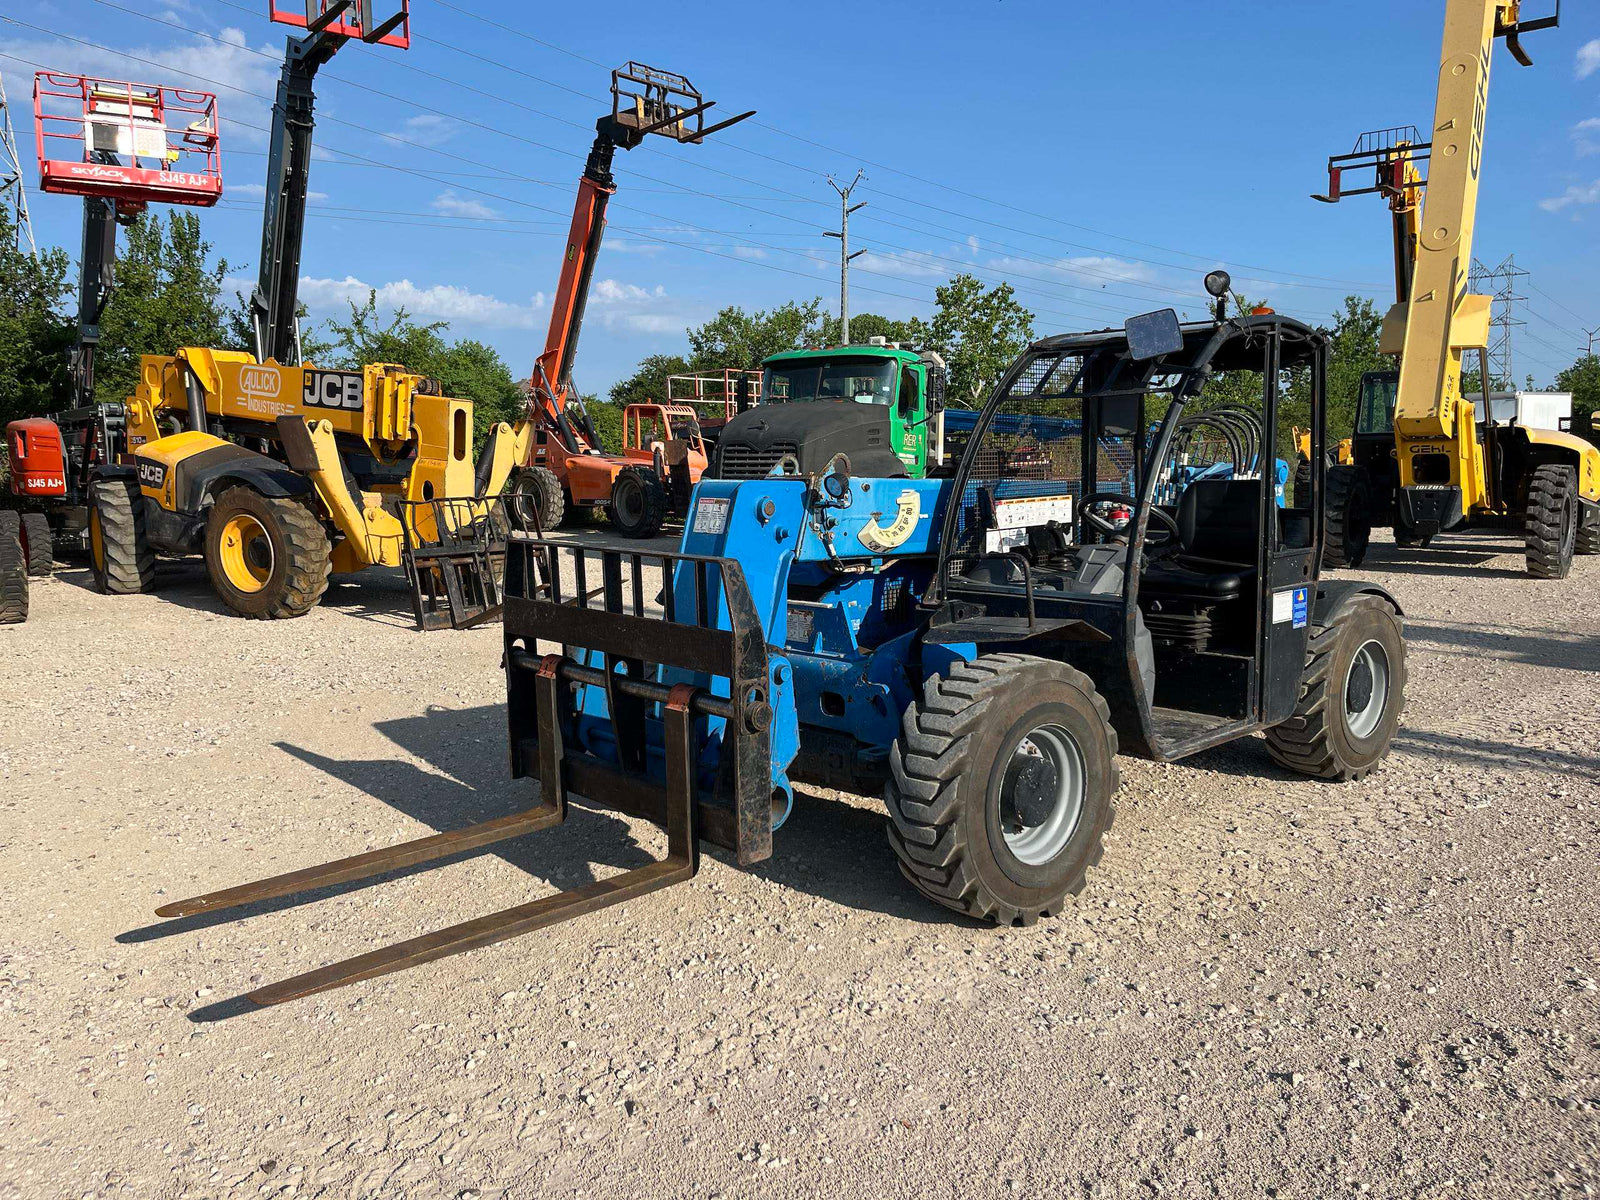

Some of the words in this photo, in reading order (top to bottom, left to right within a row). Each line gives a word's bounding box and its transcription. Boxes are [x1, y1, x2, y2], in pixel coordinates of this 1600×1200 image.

[1470, 37, 1491, 181] GEHL
[71, 166, 124, 178] SKYJACK
[159, 172, 186, 184] SJ45
[189, 175, 208, 186] AJ+
[243, 371, 276, 392] AULICK
[304, 373, 363, 408] JCB
[246, 397, 286, 415] INDUSTRIES
[1409, 445, 1451, 453] GEHL
[140, 464, 164, 483] JCB
[27, 478, 46, 488] SJ45
[48, 479, 63, 488] AJ+
